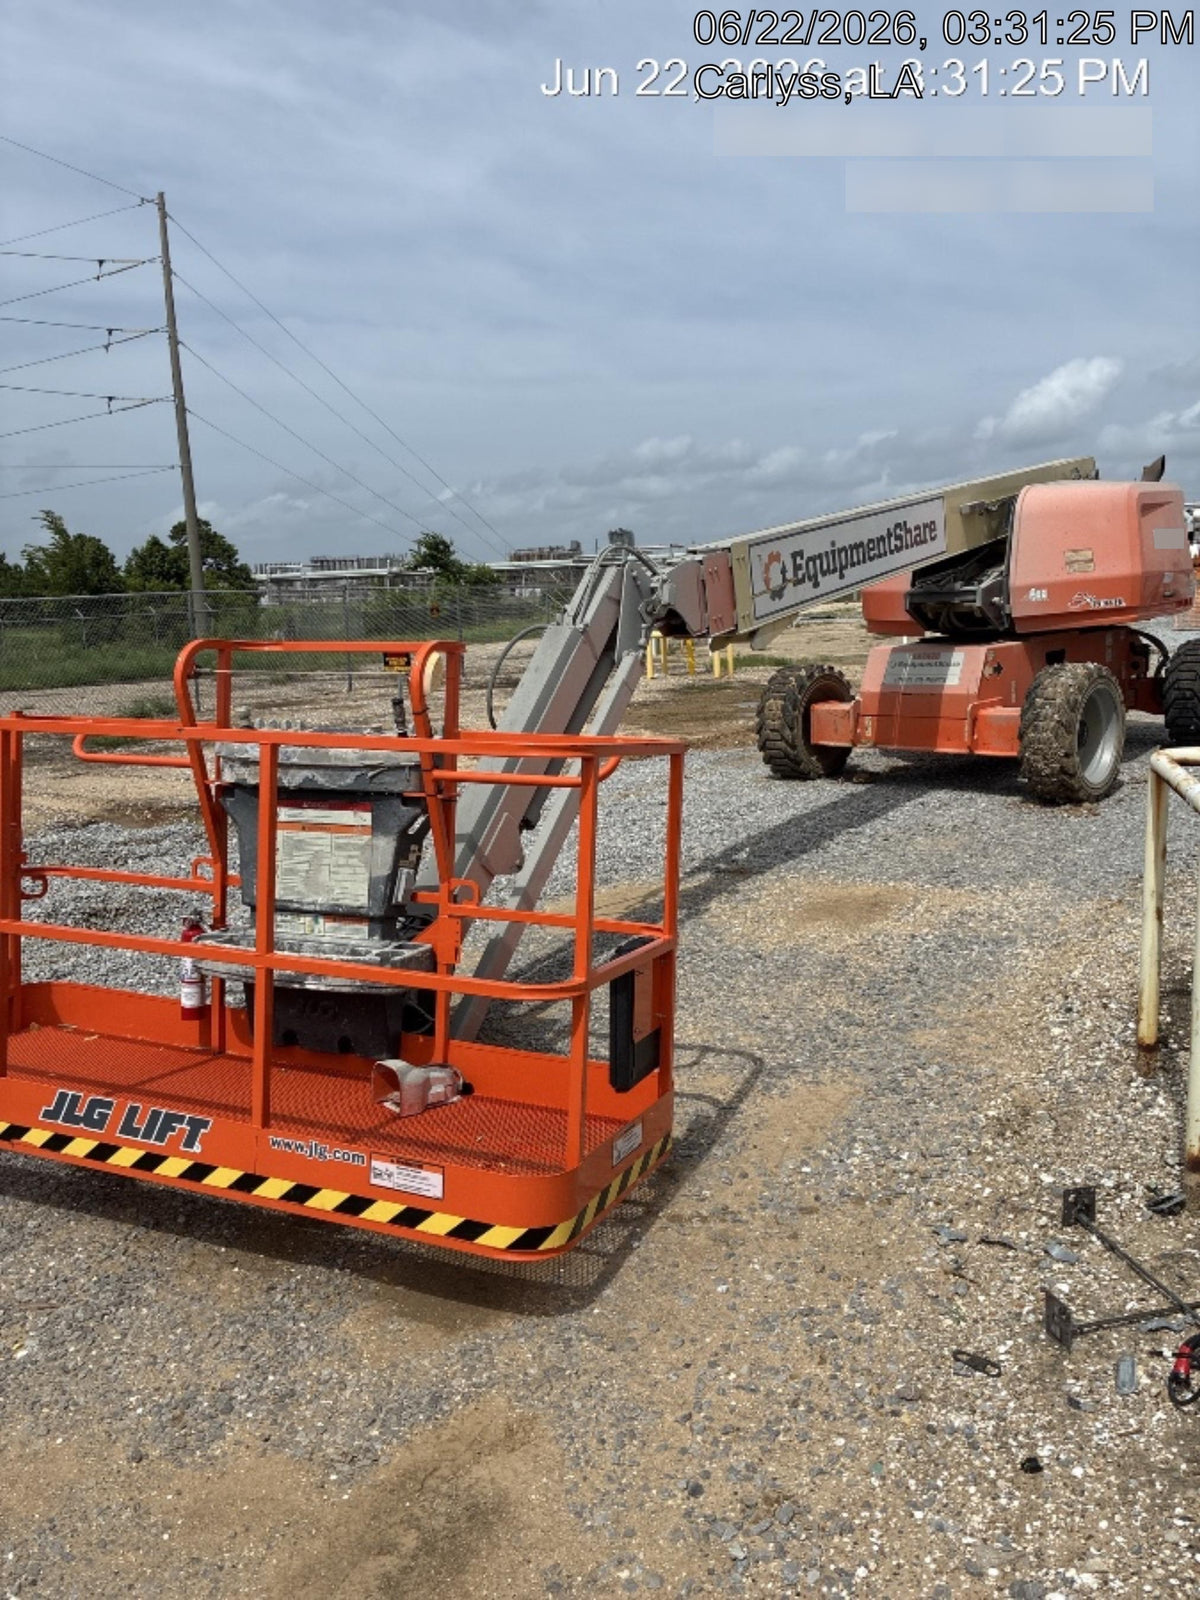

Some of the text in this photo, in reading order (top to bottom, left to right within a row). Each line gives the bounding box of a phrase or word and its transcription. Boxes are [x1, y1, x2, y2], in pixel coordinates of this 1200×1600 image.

[790, 520, 938, 589] EquipmentShare
[39, 1089, 214, 1153] JLG LIFT
[268, 1135, 368, 1168] www.jlg.com
